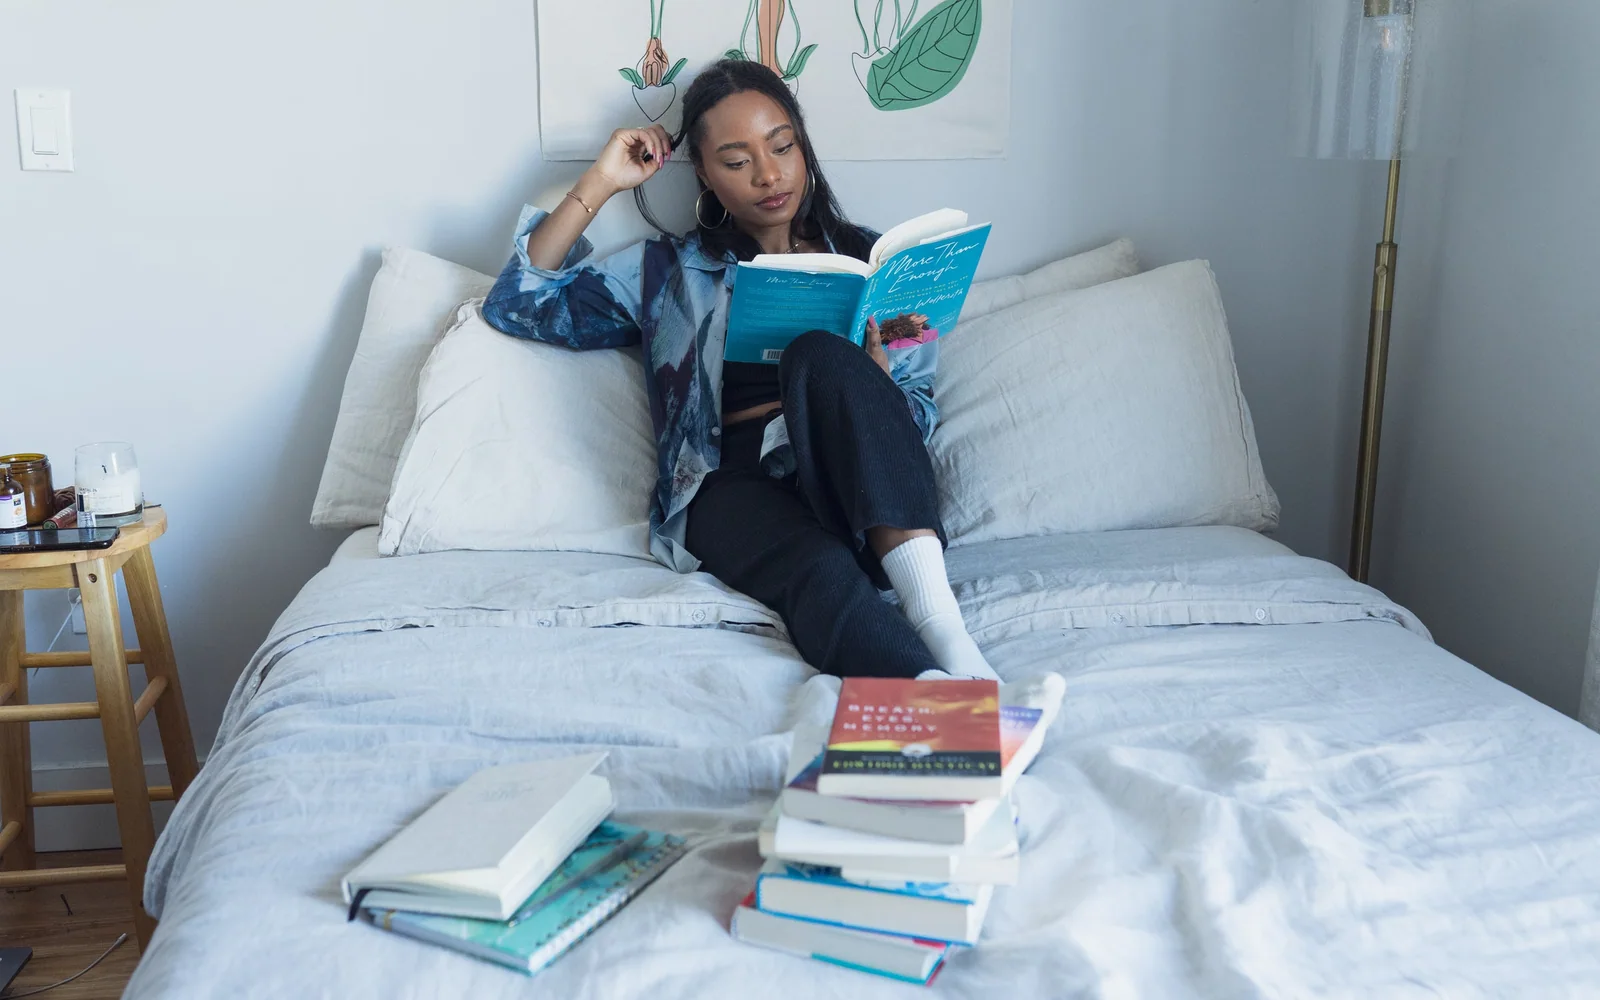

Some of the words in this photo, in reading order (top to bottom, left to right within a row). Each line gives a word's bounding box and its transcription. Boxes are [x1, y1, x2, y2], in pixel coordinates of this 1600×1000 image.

[885, 254, 934, 279] More
[935, 241, 980, 265] Than
[888, 259, 959, 293] Enough
[872, 304, 912, 318] Elaine
[915, 288, 964, 310] Welteroth
